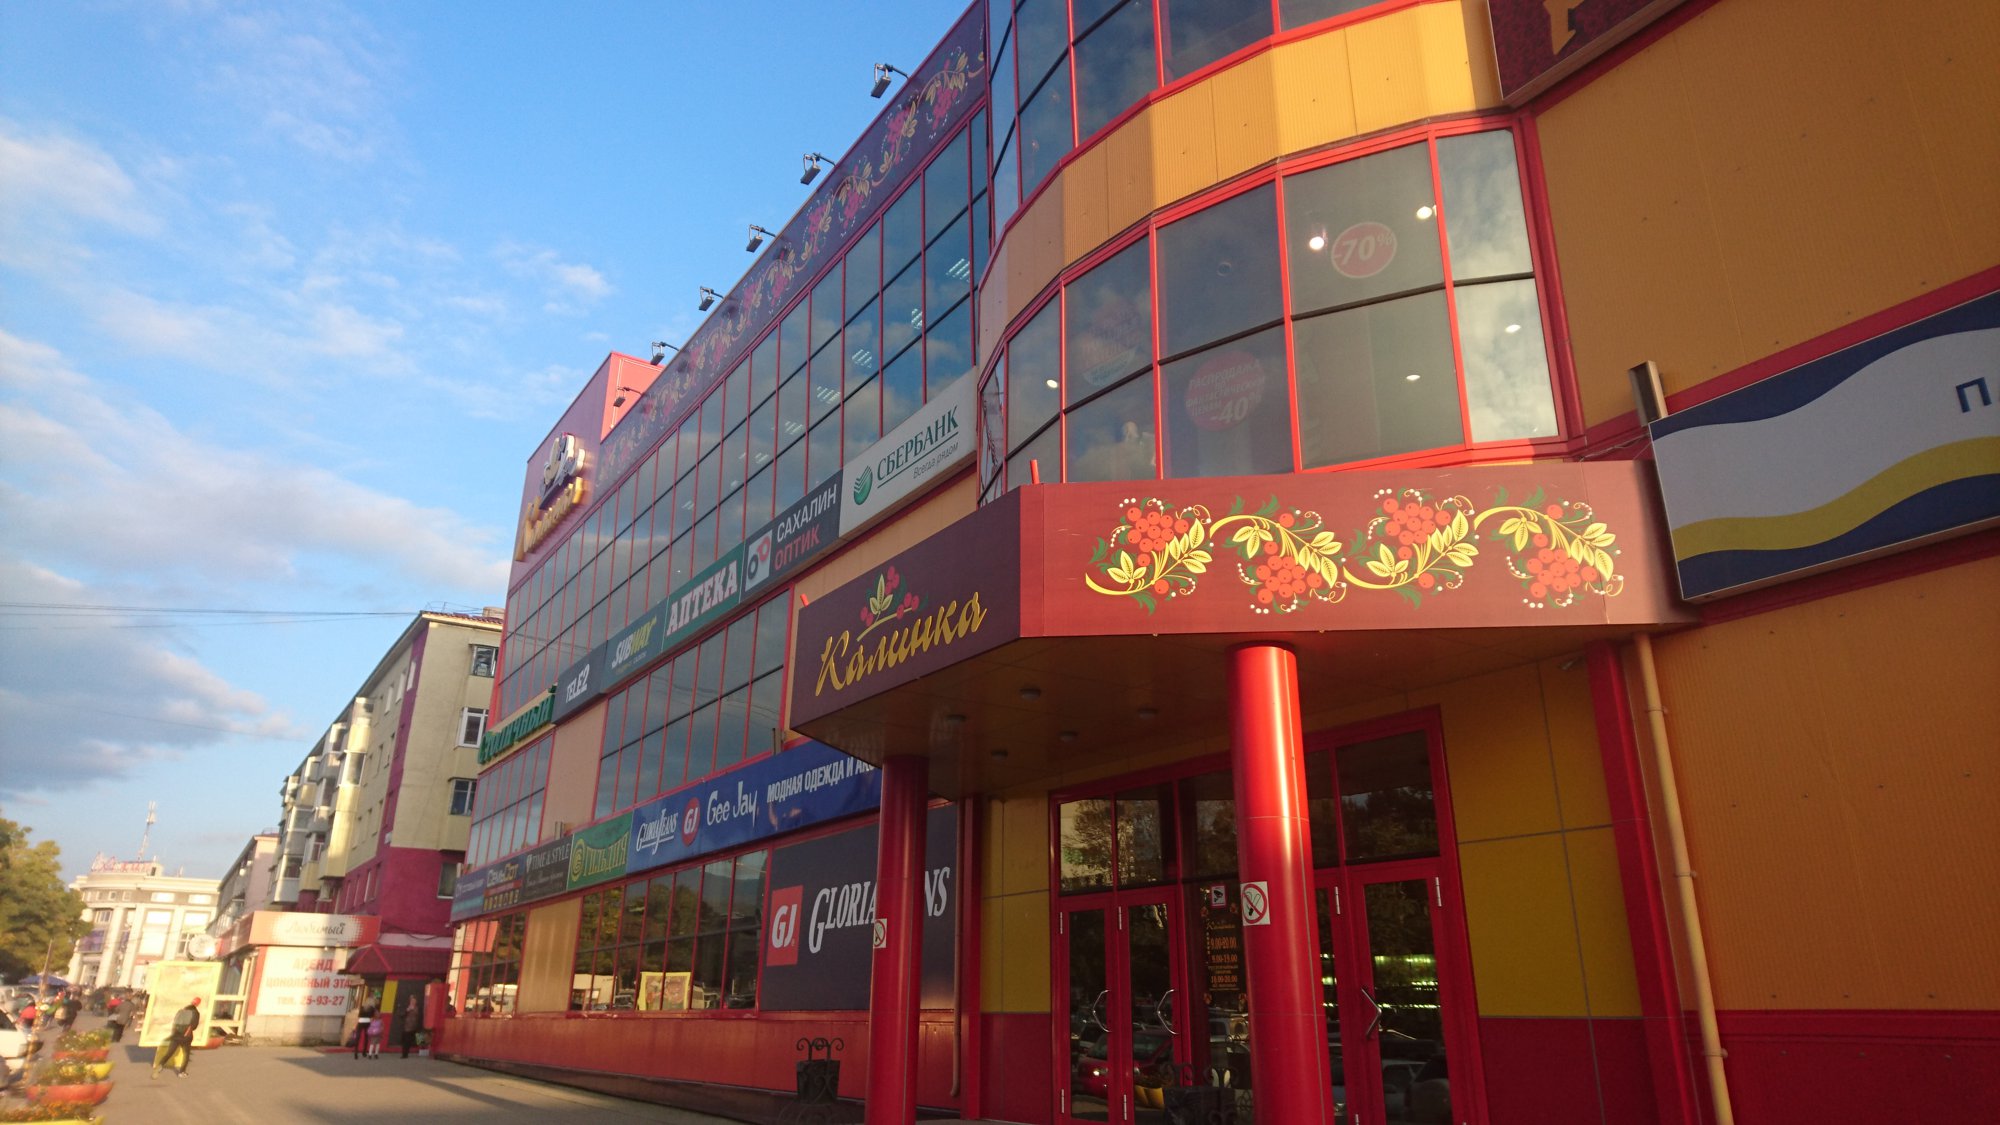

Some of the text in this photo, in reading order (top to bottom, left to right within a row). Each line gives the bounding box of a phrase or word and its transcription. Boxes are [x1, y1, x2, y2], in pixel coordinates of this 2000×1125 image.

[1334, 233, 1393, 265] -70%
[1956, 377, 1999, 413] П
[877, 405, 959, 481] СБЕРБАНК
[913, 442, 959, 479] Всегда рядом
[777, 484, 837, 542] САХАЛИН
[775, 528, 820, 571] ОПТИК
[666, 560, 738, 637] АПТЕКА
[612, 615, 657, 669] SUBWAY
[815, 592, 987, 696] Калинка
[566, 664, 590, 703] TELE2
[767, 776, 803, 803] МОДНАЯ
[805, 766, 844, 792] ОДЕЖДА
[846, 756, 854, 778] И
[684, 808, 699, 834] GJ
[707, 781, 758, 828] Gee Jay
[771, 904, 798, 948] GJ
[300, 995, 345, 1006] 25-93-27
[333, 978, 352, 989] ЭТА
